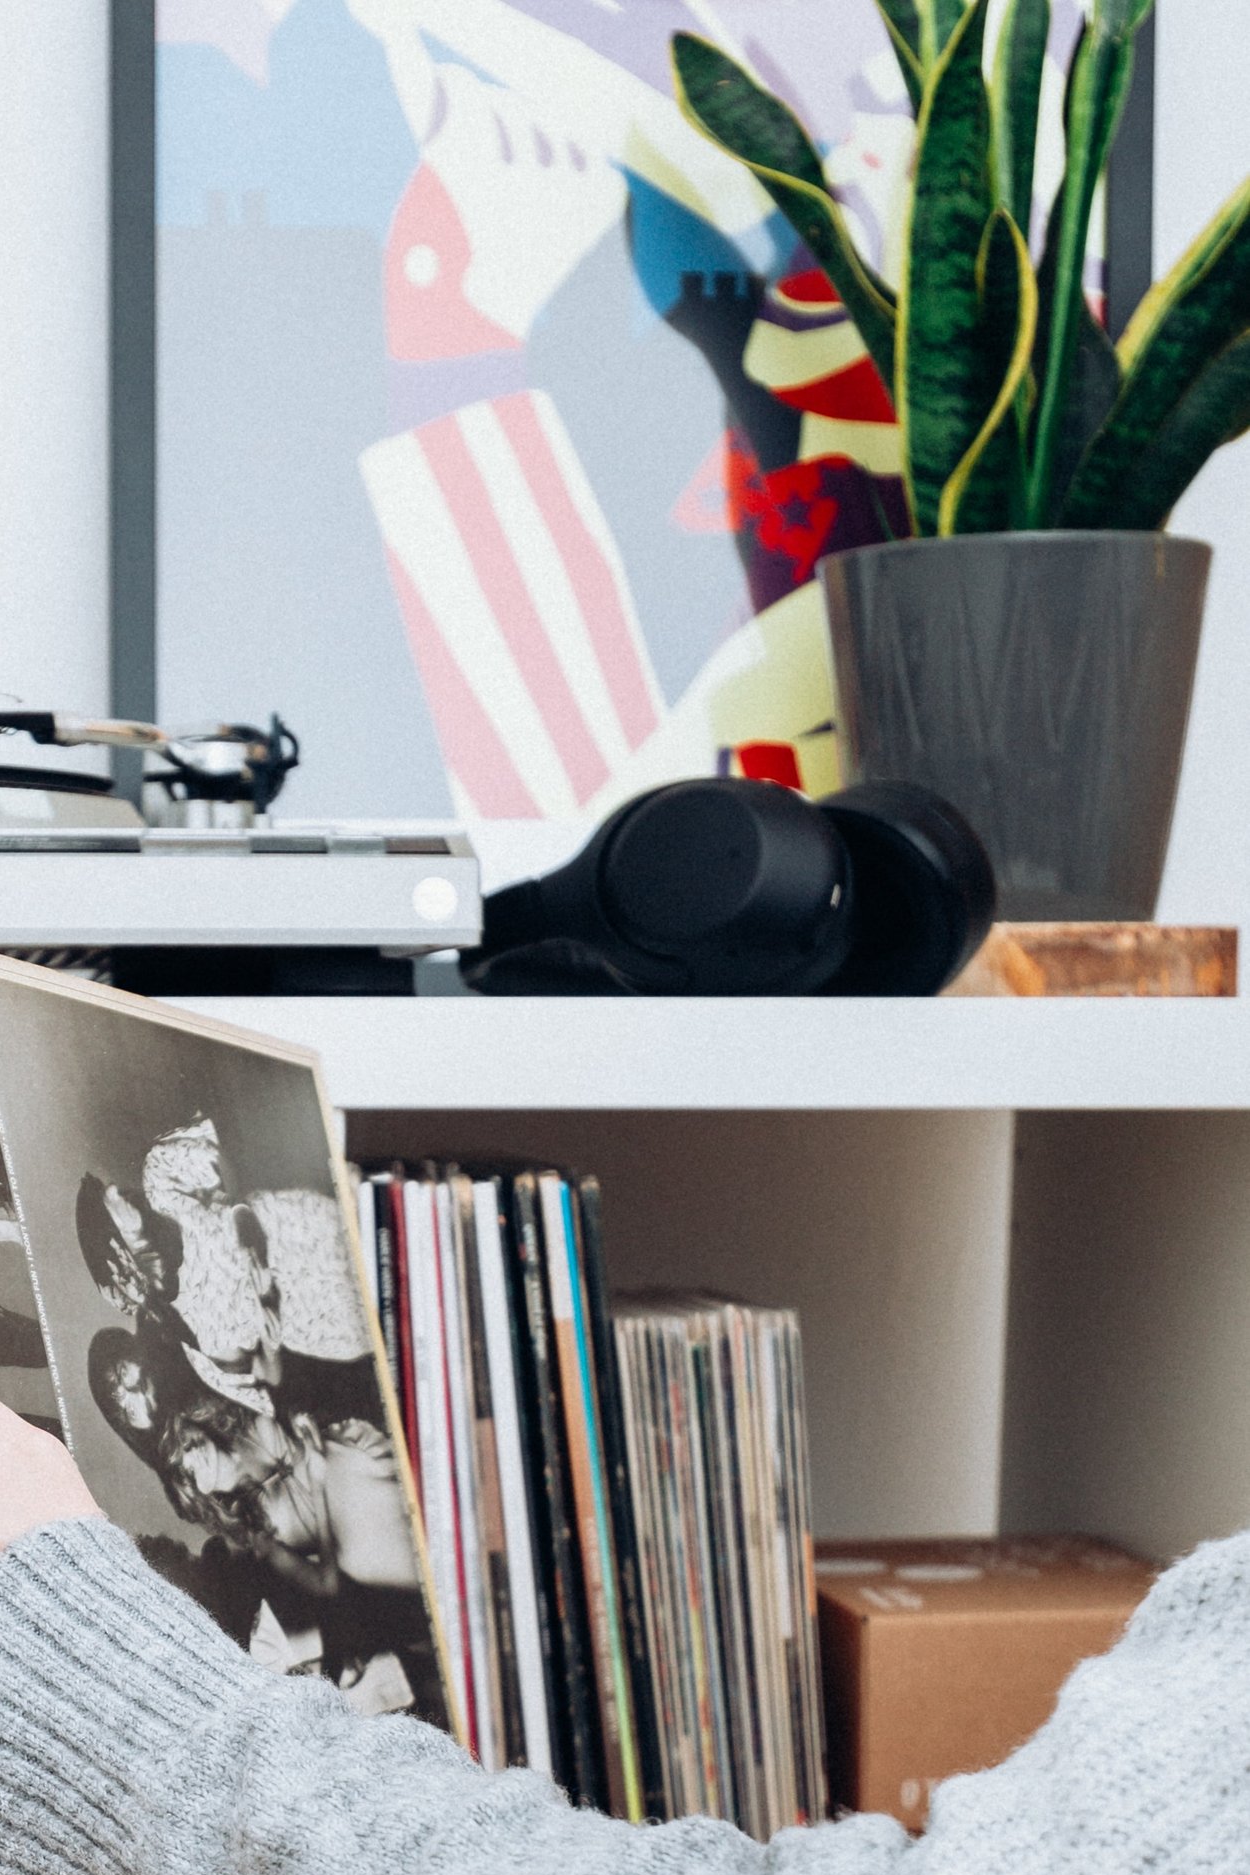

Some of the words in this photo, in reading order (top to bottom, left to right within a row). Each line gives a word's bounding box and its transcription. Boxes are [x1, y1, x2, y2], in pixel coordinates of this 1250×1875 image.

[2, 1143, 15, 1175] KNOW
[10, 1176, 18, 1190] TO
[13, 1192, 26, 1223] WANT
[30, 1269, 41, 1292] FUN
[35, 1293, 49, 1333] LOVING
[43, 1333, 56, 1363] MAKE
[51, 1364, 61, 1387] YOU
[57, 1396, 70, 1430] CHAIN
[64, 1431, 74, 1451] THE
